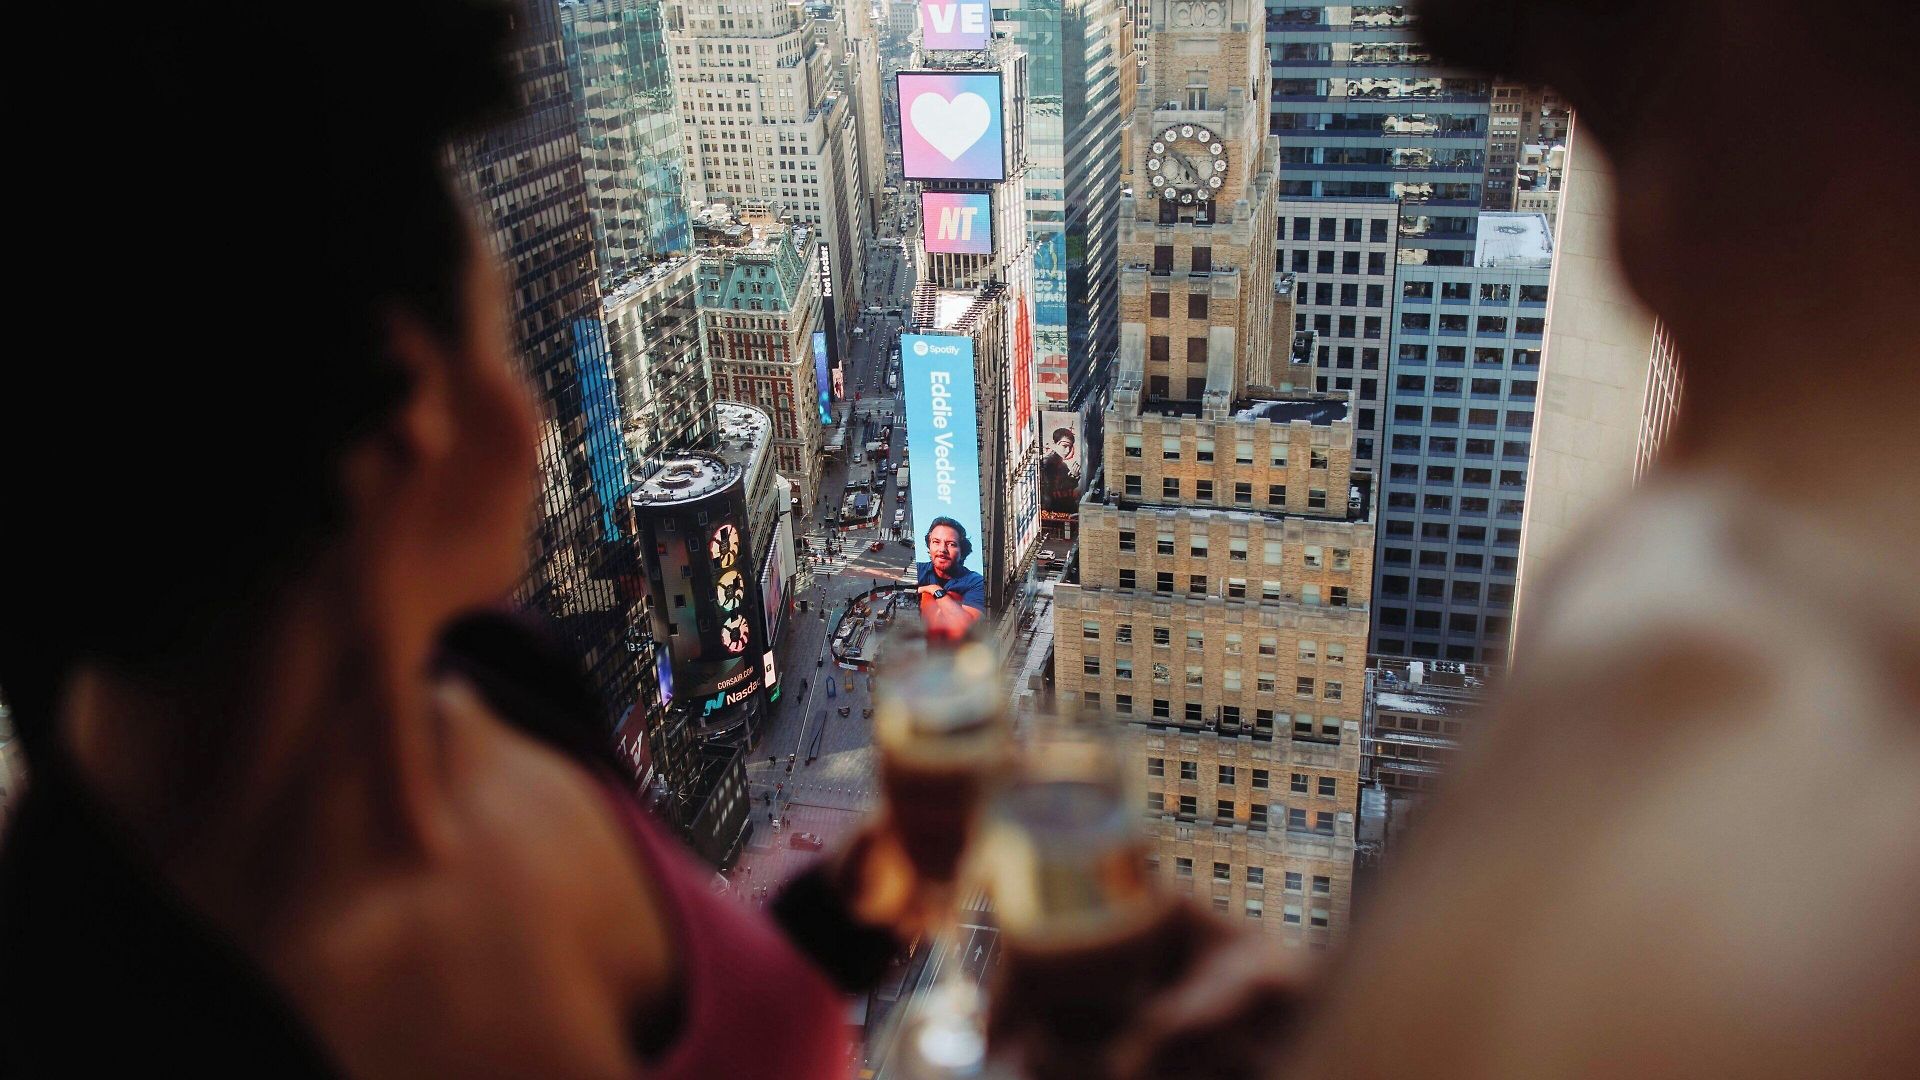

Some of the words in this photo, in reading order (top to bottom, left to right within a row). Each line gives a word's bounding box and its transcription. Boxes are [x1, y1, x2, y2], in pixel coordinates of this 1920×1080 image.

[927, 4, 985, 34] VE
[937, 207, 978, 241] NT
[929, 344, 960, 356] Spotify
[930, 371, 952, 429] Eddie
[934, 431, 956, 505] Vedder
[717, 666, 754, 690] CORSAIR.COM
